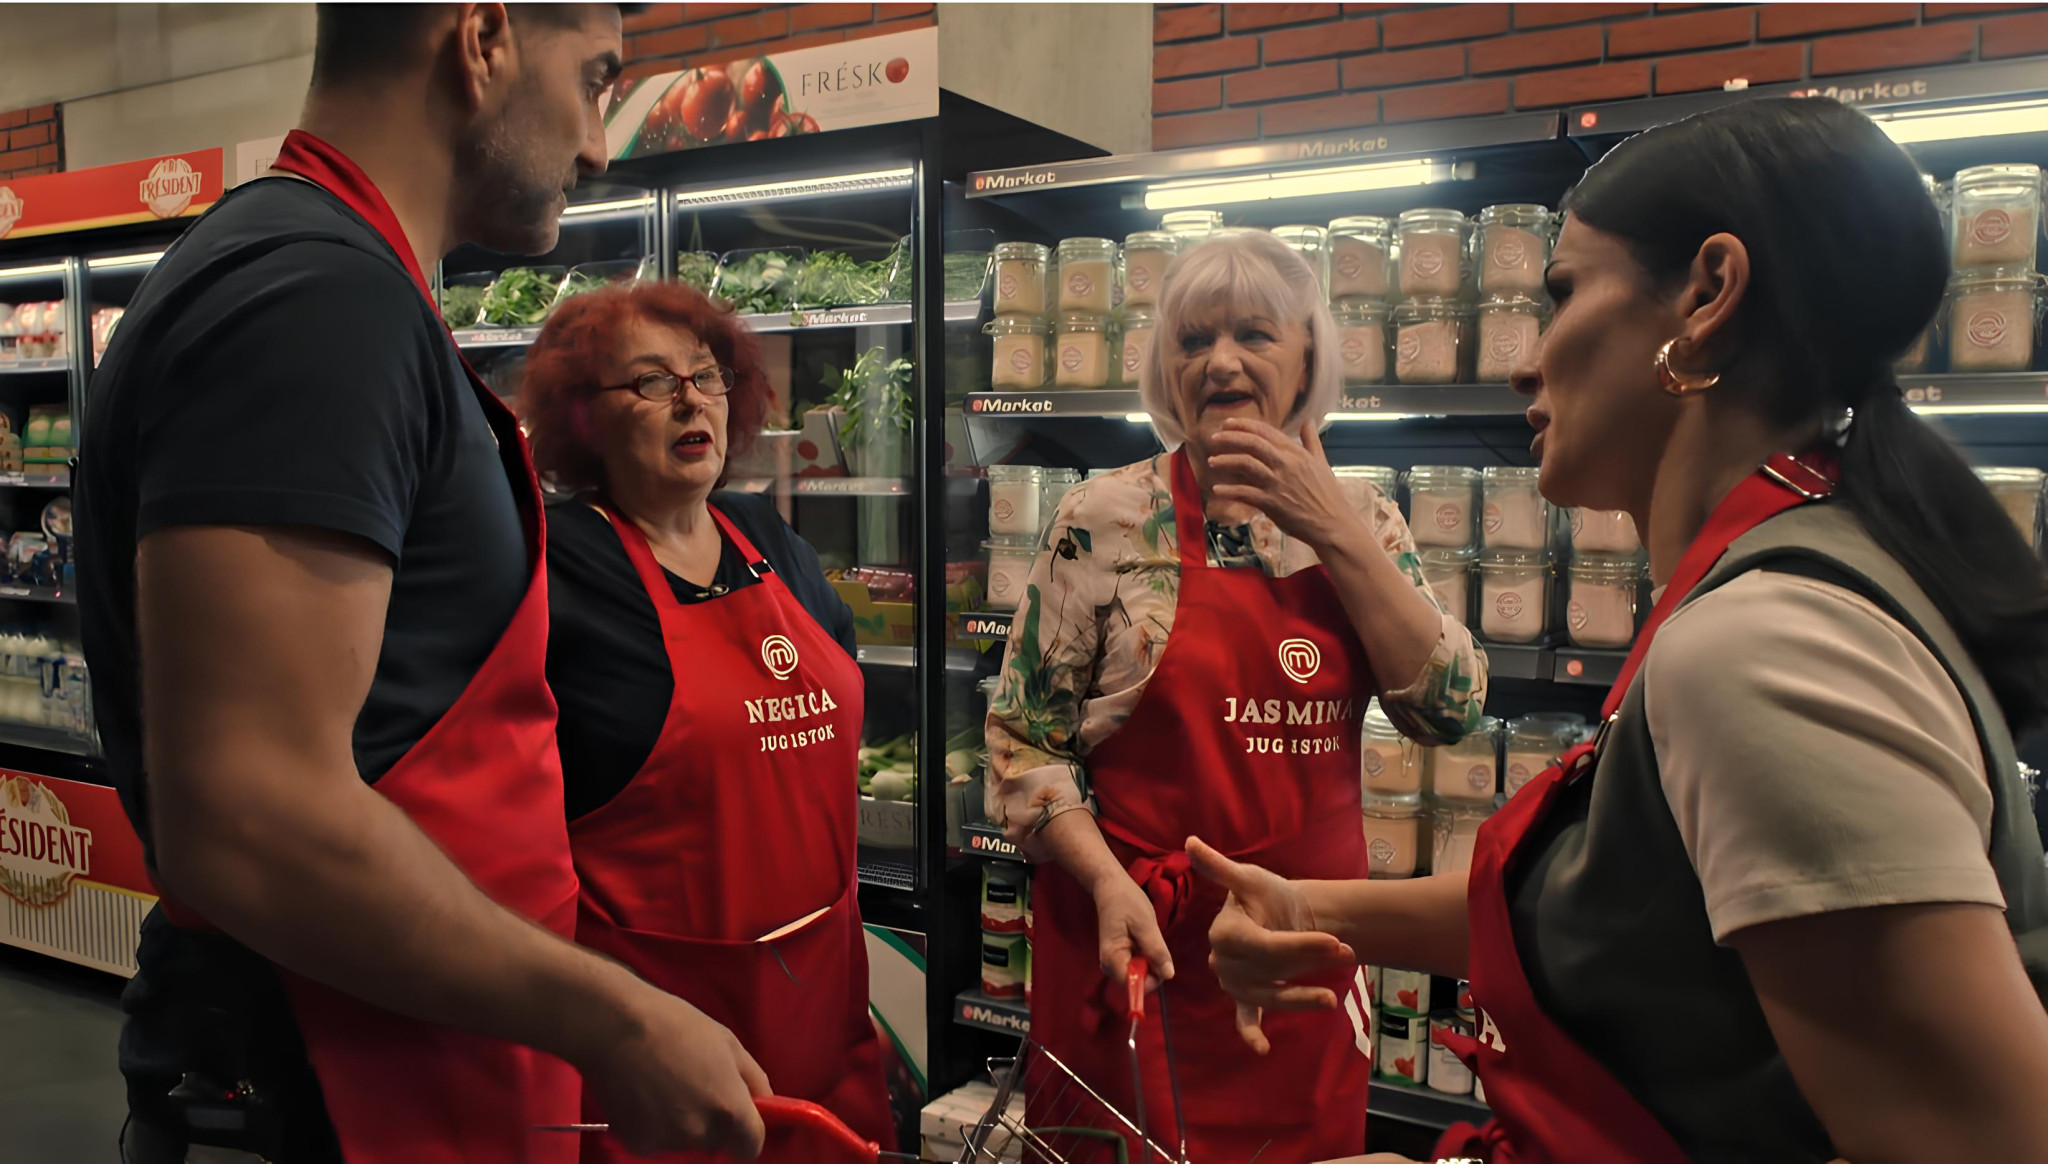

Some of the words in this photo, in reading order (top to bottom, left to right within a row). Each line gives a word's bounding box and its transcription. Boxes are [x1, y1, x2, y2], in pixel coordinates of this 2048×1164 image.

[977, 620, 1012, 635] Mar
[744, 687, 838, 724] NEGICA
[1223, 697, 1353, 726] JASMINA
[760, 734, 789, 752] JUG
[1246, 737, 1284, 754] JUG
[1291, 735, 1341, 755] ISTOK
[981, 835, 1017, 854] Mar
[973, 1006, 1030, 1032] Marke
